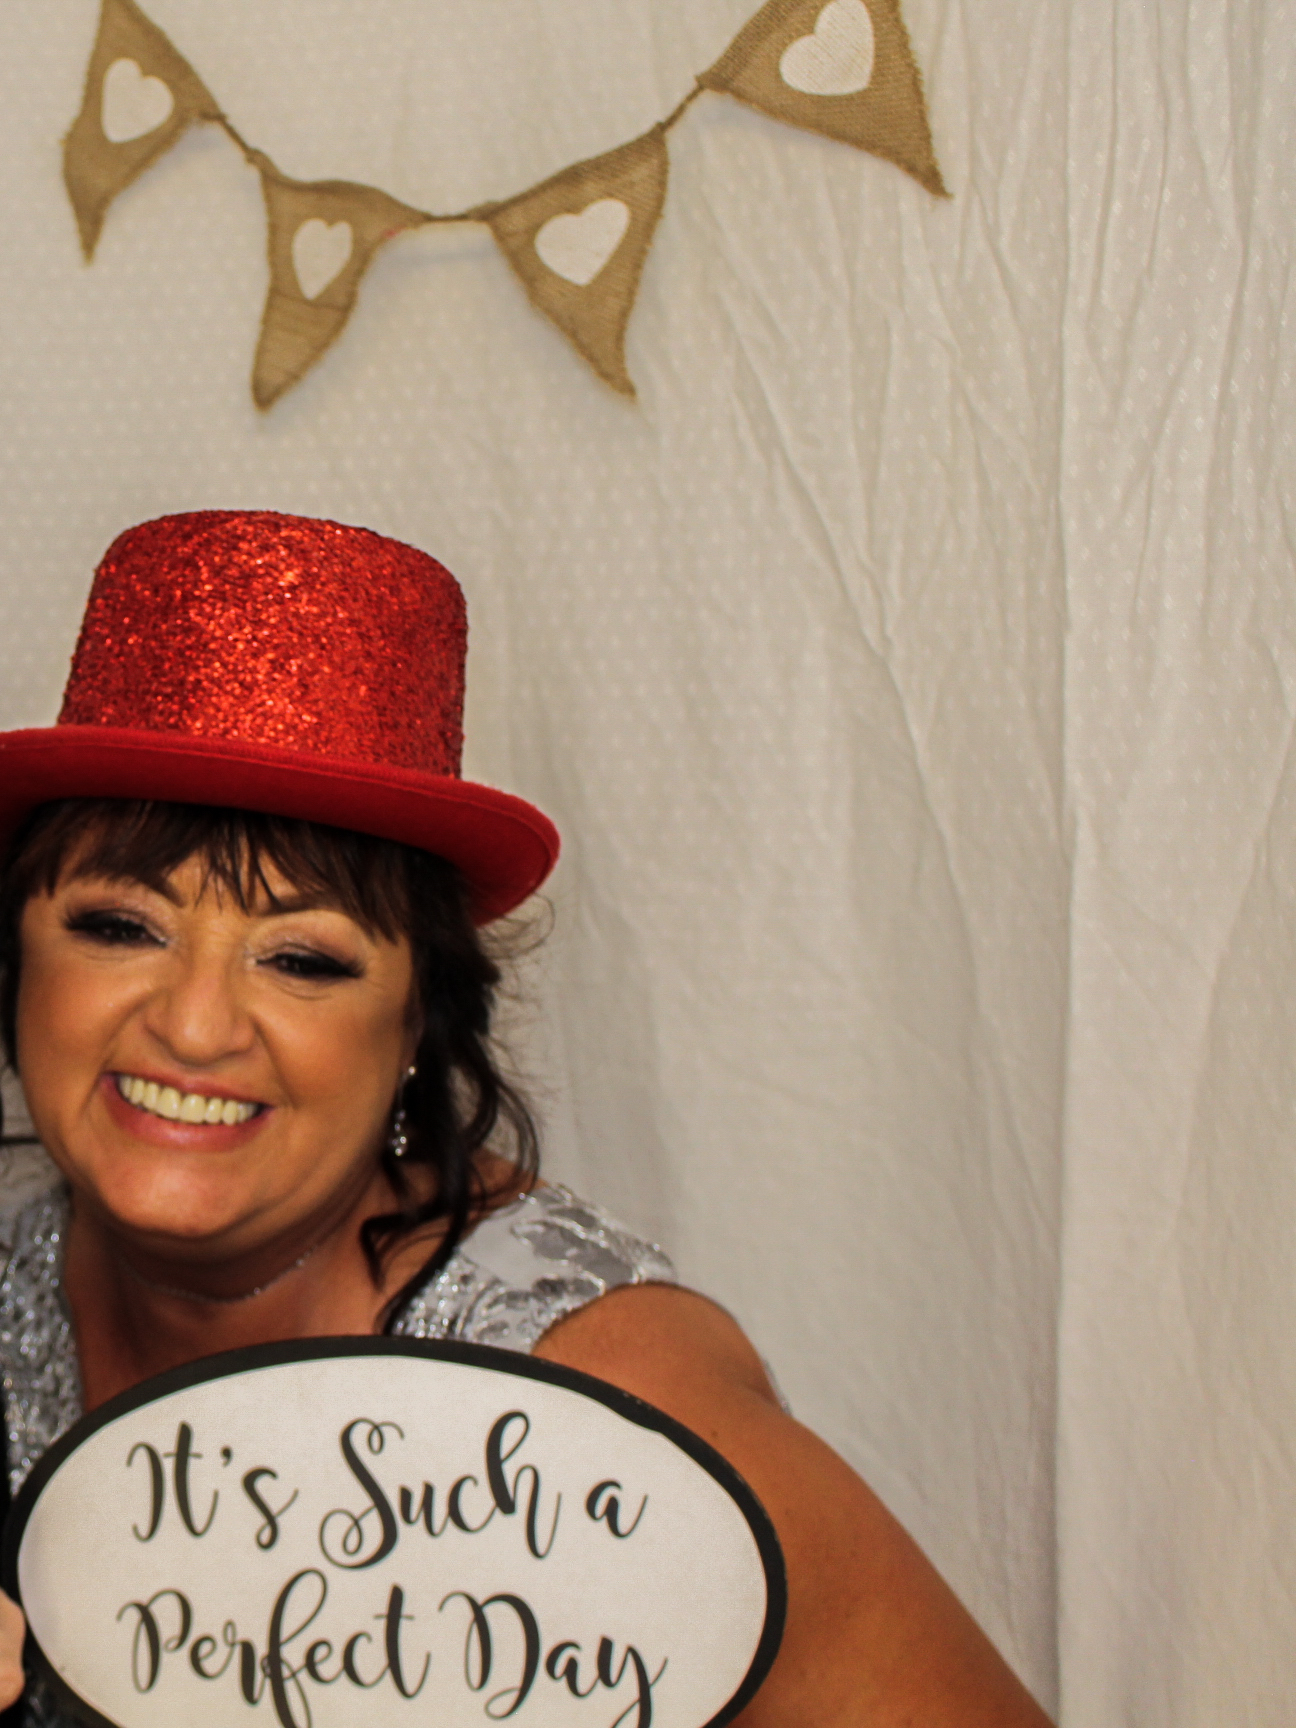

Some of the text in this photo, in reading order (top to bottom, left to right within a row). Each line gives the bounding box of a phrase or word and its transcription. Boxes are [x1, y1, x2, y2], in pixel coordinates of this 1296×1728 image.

[126, 1409, 648, 1569] It's Such a
[117, 1568, 668, 1728] Perfect Day
